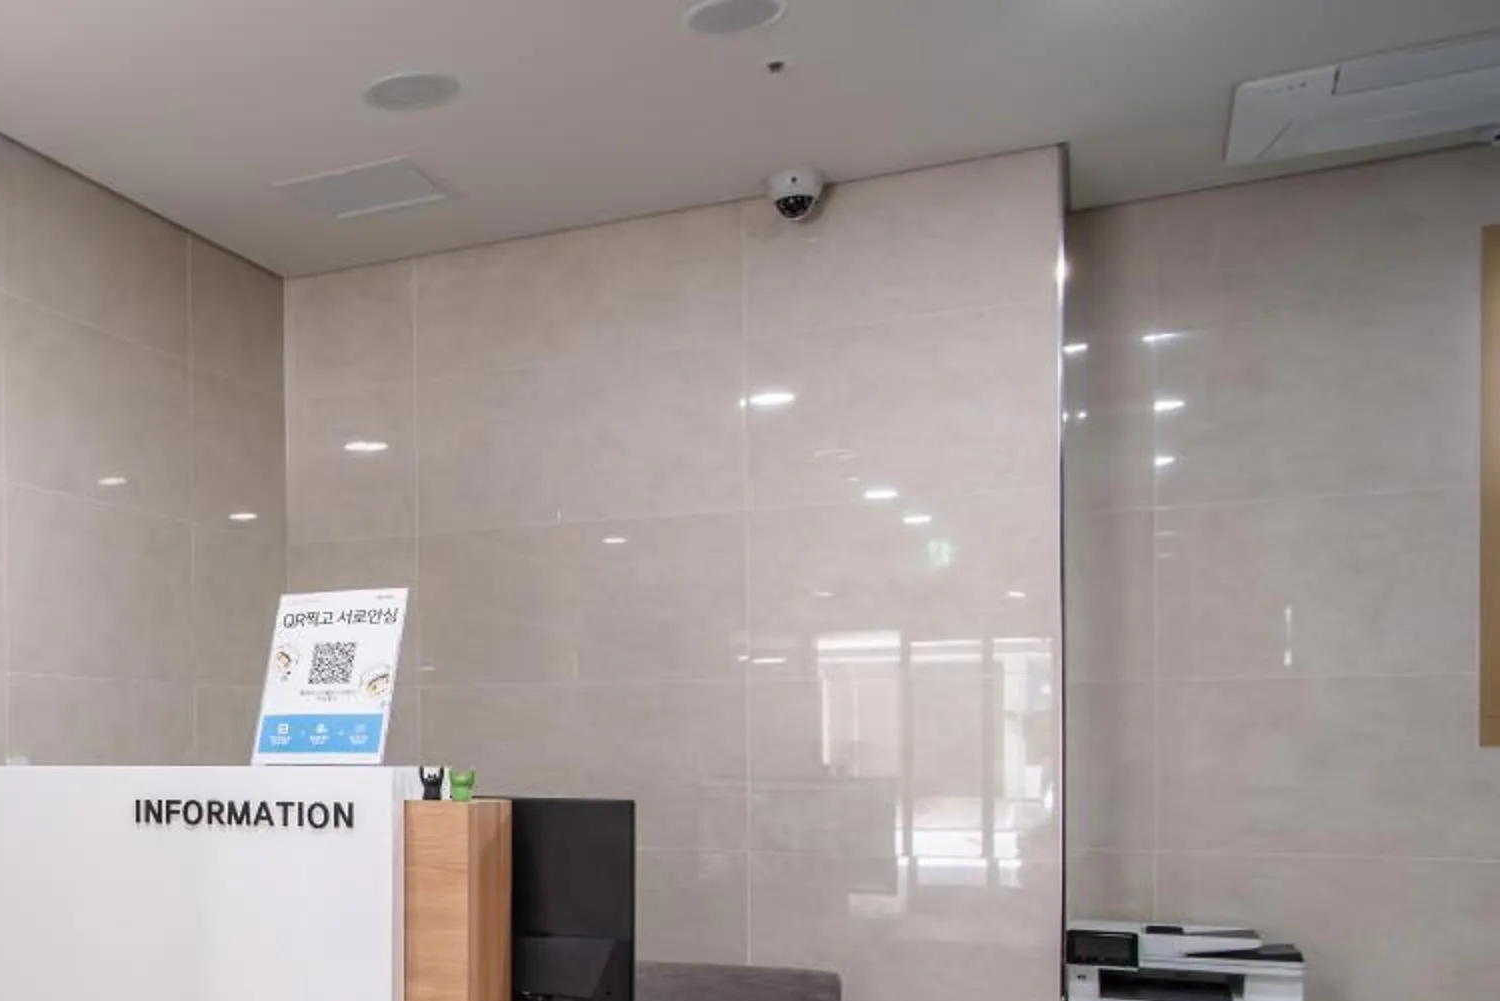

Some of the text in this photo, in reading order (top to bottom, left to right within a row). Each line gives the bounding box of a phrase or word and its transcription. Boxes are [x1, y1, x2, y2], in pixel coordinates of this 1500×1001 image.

[283, 607, 399, 629] QR찍고 서로안심
[134, 798, 356, 830] INFORMATION
